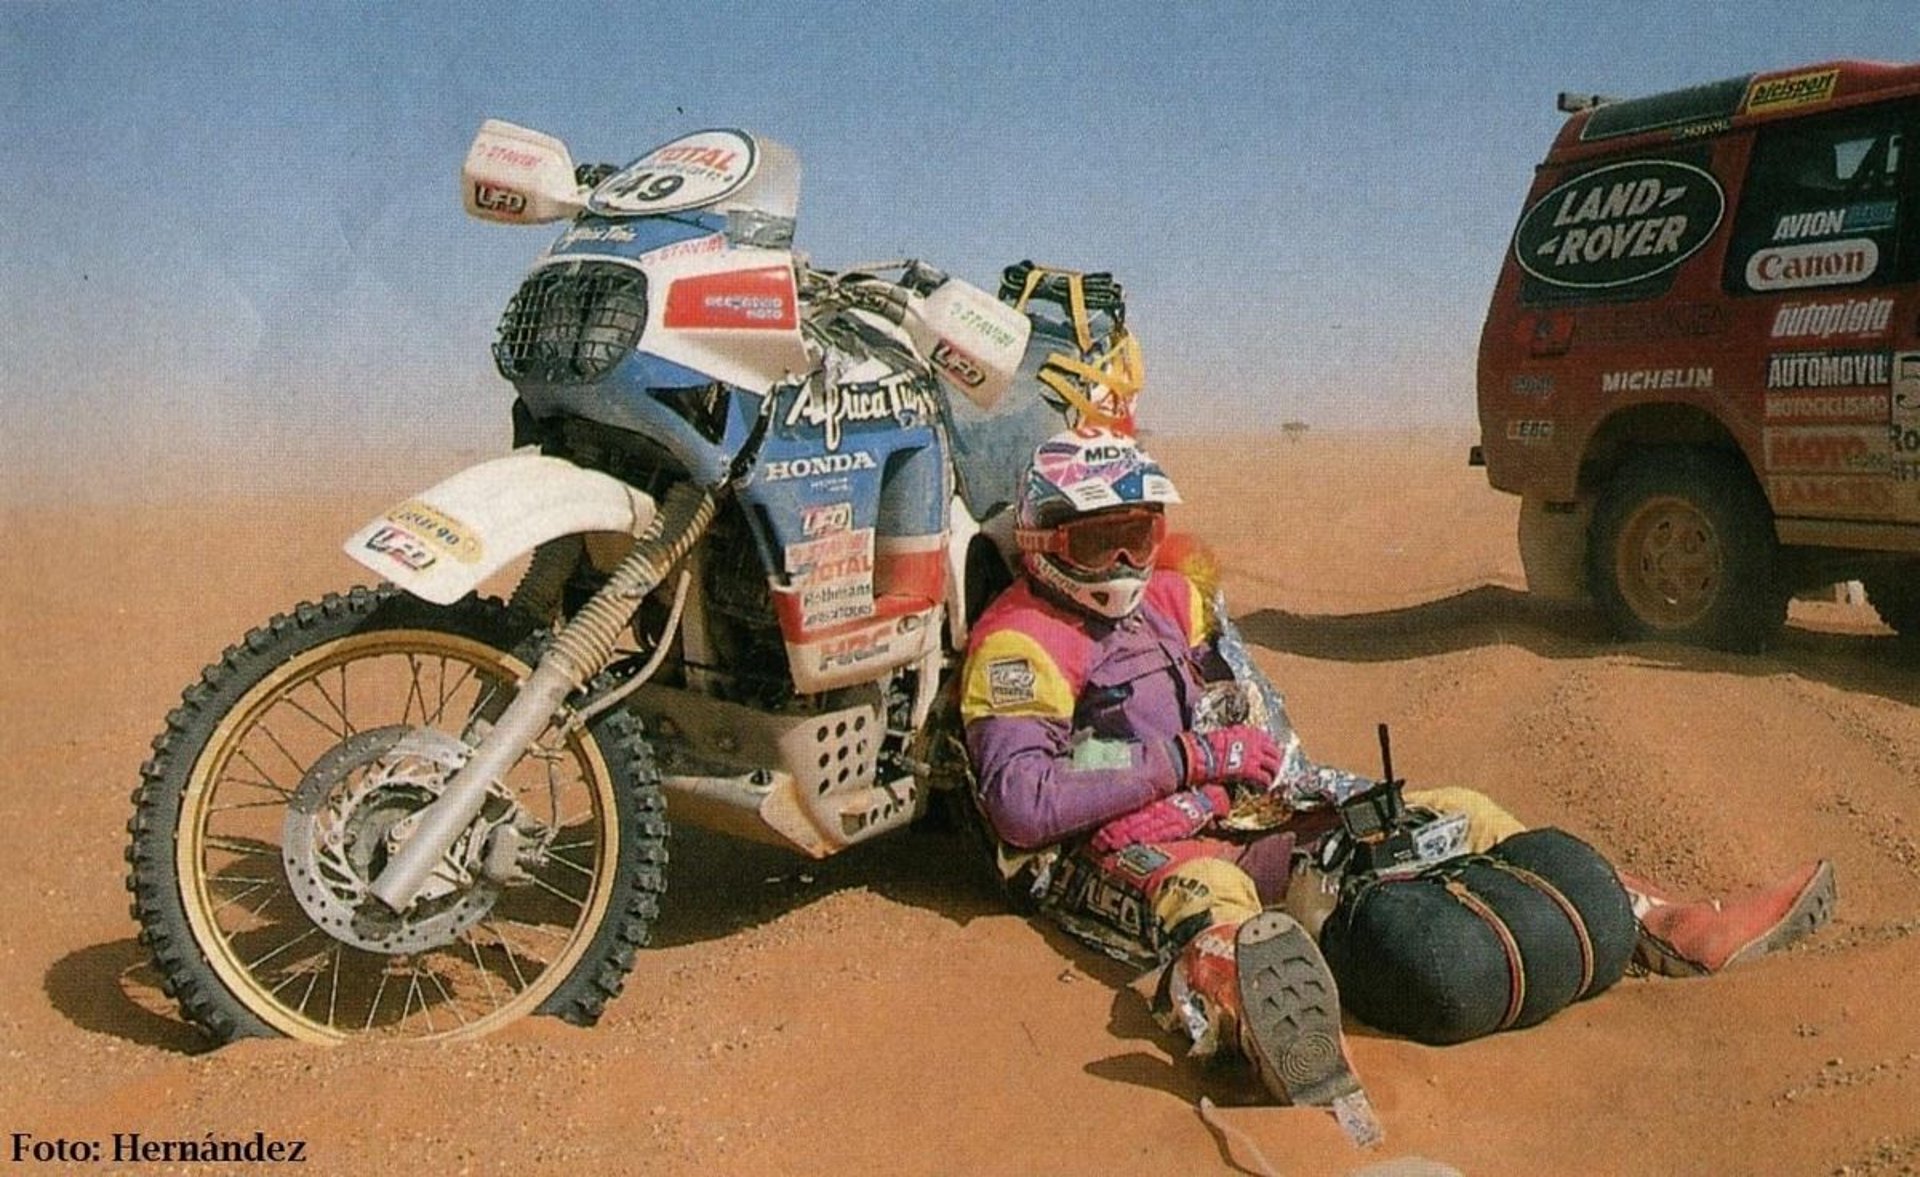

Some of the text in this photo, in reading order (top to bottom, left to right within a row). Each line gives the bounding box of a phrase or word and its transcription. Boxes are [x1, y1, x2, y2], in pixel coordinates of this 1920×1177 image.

[614, 172, 685, 202] 49
[1554, 178, 1662, 228] LAND
[1555, 214, 1689, 267] ROVER
[1772, 208, 1846, 241] AVION
[1756, 250, 1866, 282] Canon
[1602, 367, 1714, 393] MICHELIN
[1767, 354, 1889, 389] AUTOMOVIL
[785, 373, 893, 452] Africa
[765, 450, 877, 482] HONDA
